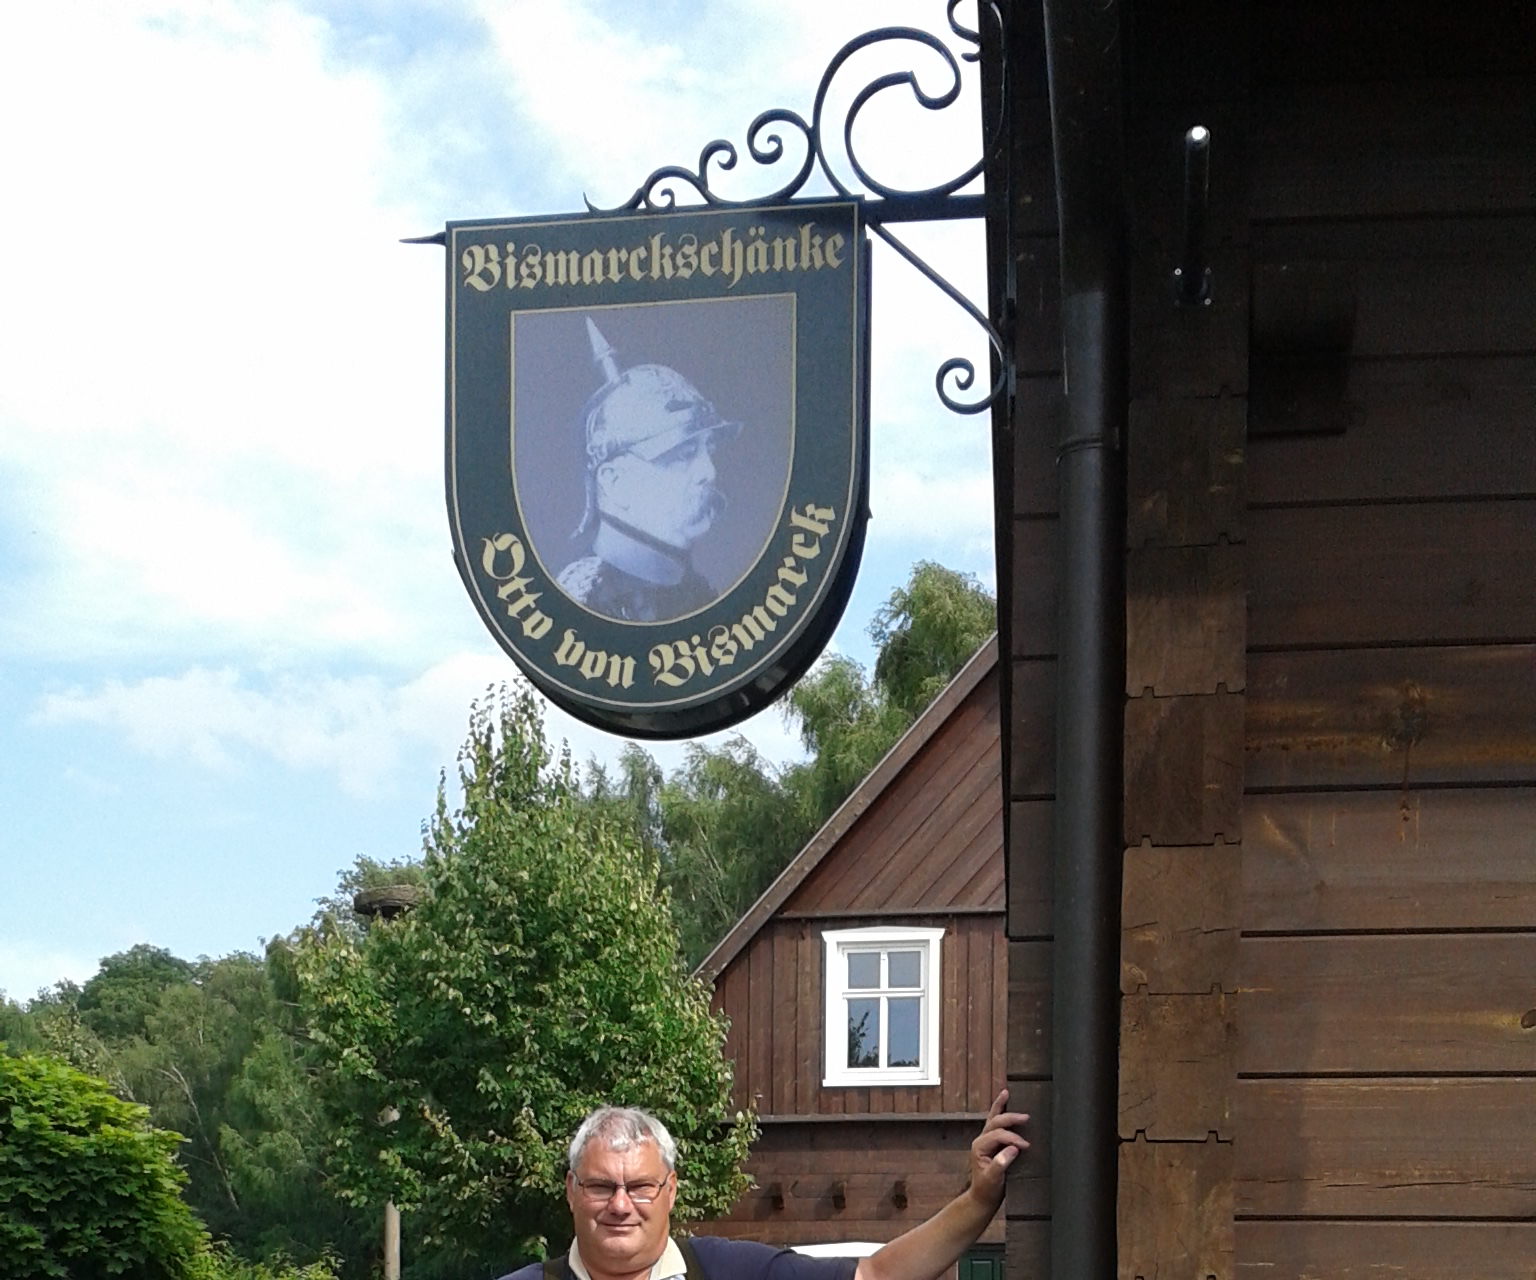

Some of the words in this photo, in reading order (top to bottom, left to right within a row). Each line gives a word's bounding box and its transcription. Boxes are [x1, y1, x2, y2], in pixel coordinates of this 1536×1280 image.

[462, 223, 845, 291] Bismarckschänke
[482, 532, 553, 640] Otto
[554, 628, 637, 689] von
[648, 503, 836, 687] Bismarck
